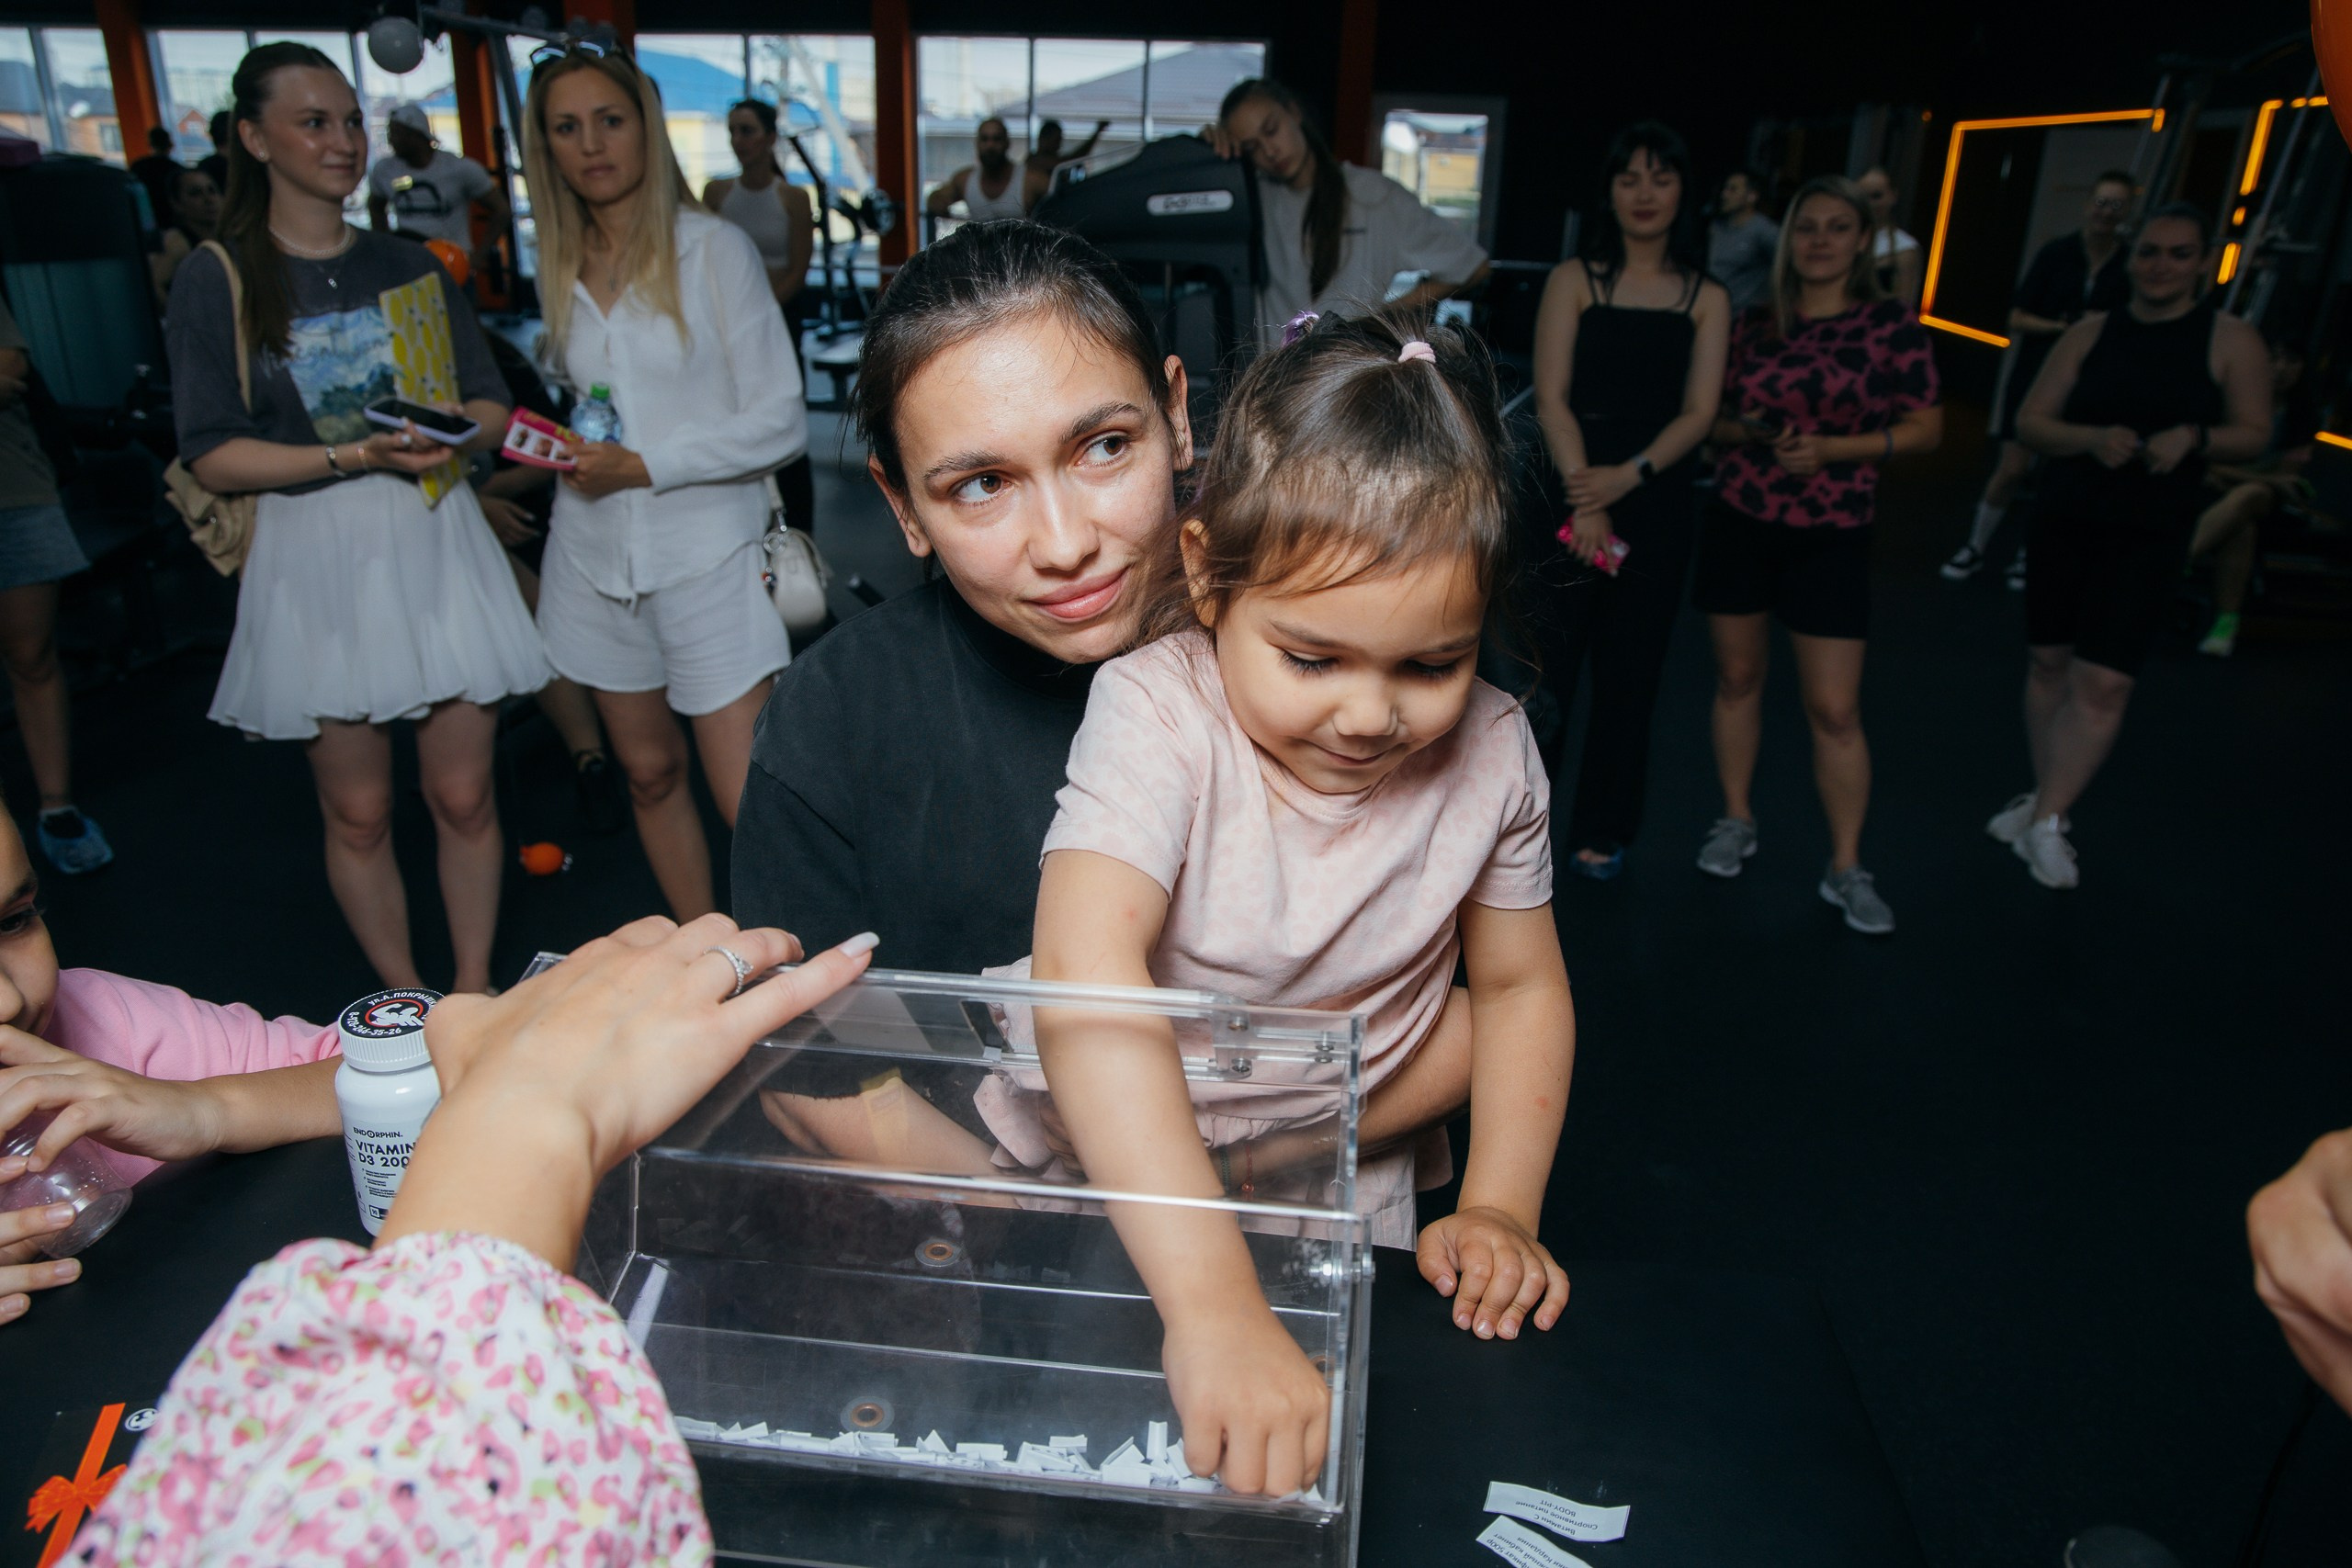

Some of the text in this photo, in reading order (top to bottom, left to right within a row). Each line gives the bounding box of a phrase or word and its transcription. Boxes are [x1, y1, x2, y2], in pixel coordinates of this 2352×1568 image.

[356, 1139, 417, 1156] VITAMIN
[358, 1152, 376, 1166] D3
[1515, 1501, 1599, 1531] Спортивное питание
[1538, 1499, 1577, 1517] BODY-PIT
[1541, 1516, 1577, 1536] Витамин
[1493, 1533, 1524, 1555] кабинет
